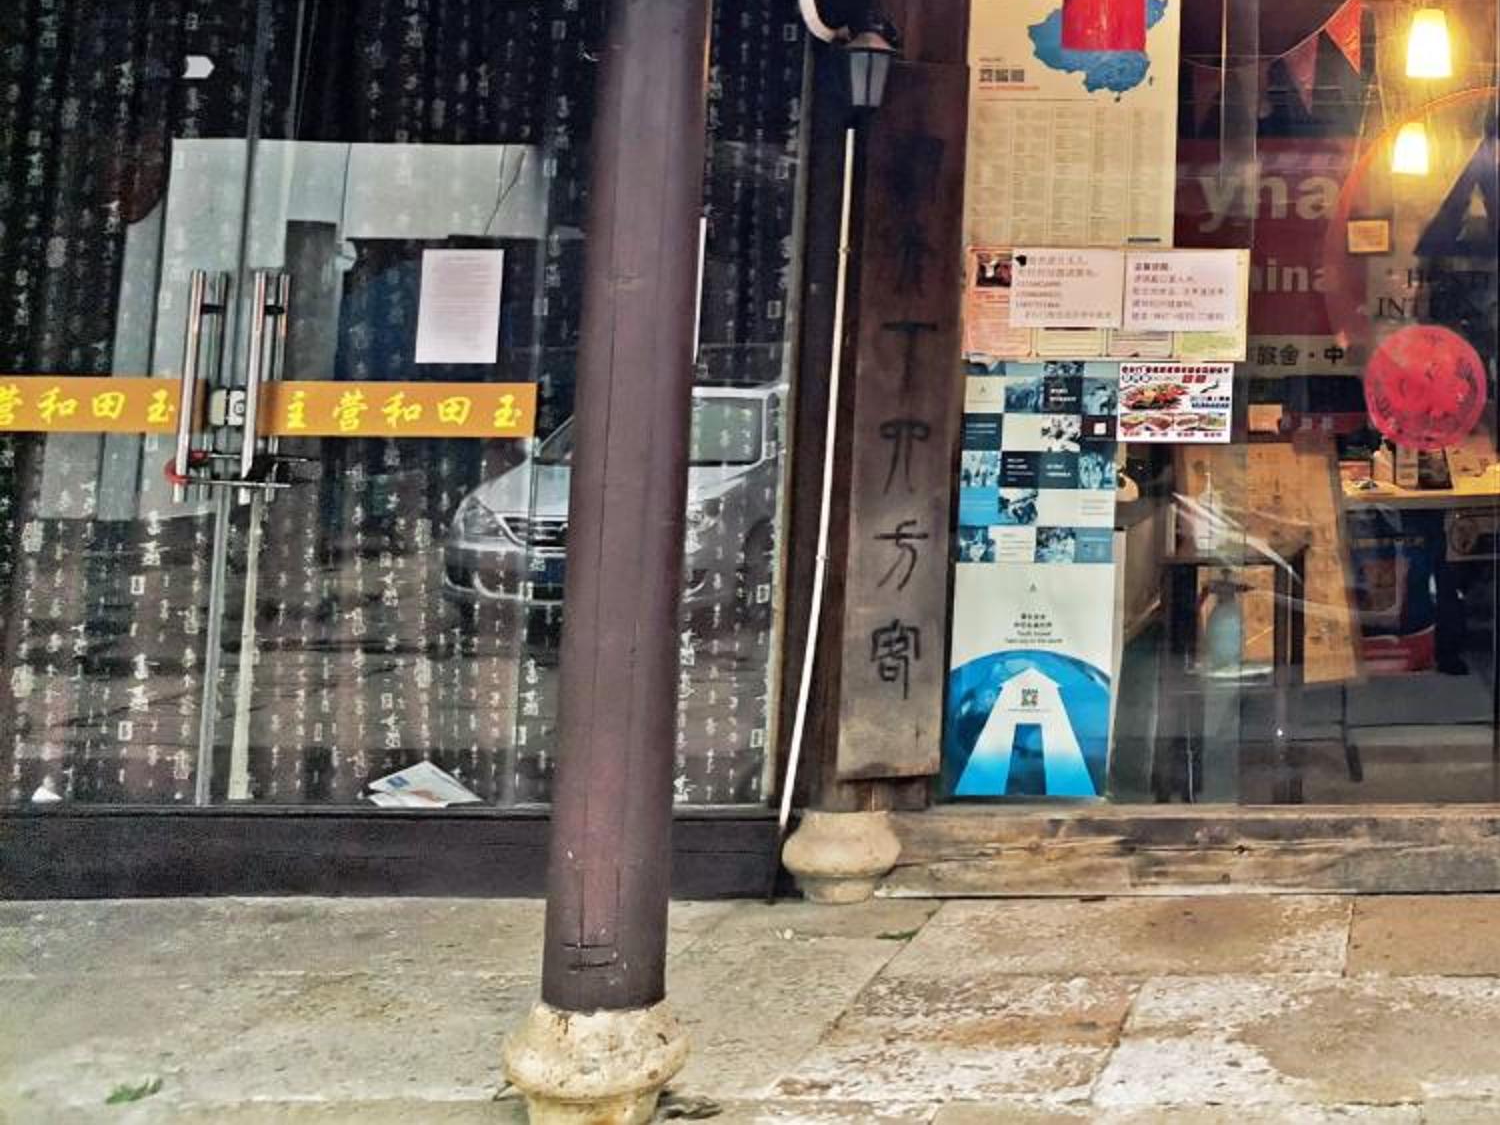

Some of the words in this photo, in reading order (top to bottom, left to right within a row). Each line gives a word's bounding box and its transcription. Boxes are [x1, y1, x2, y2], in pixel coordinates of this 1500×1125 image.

[287, 386, 523, 432] 主营和田玉
